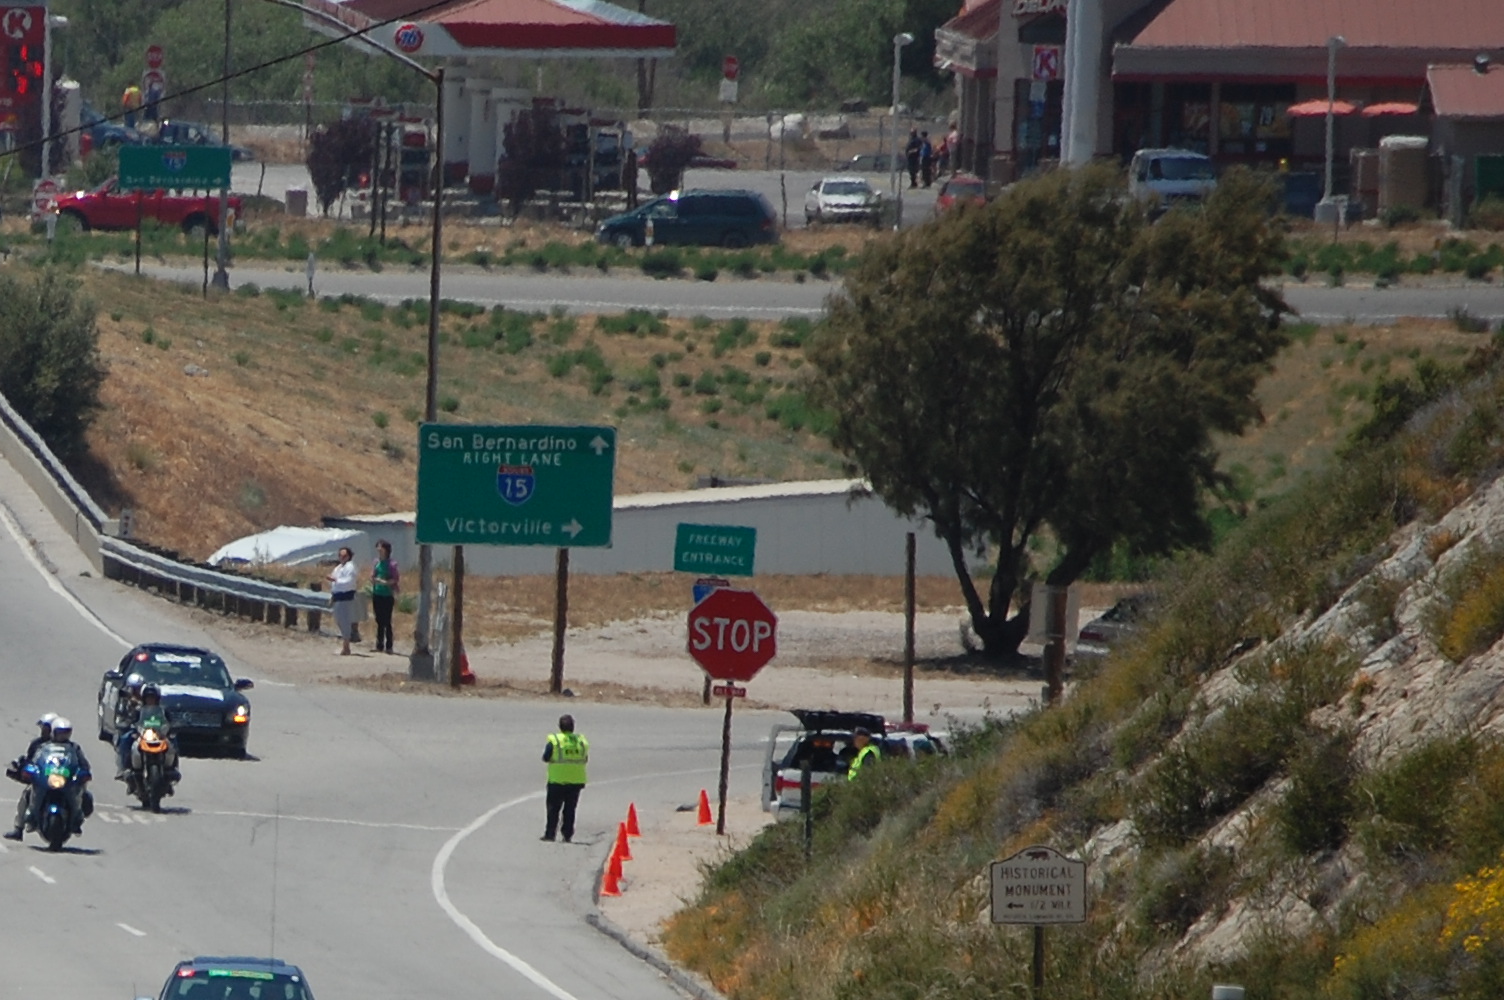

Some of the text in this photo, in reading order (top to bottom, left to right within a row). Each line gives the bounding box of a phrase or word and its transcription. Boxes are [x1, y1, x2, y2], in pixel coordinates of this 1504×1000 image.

[428, 432, 577, 450] San Bernardino
[463, 452, 562, 466] RIGHT LANE
[505, 477, 528, 498] 15
[445, 517, 553, 535] Victorville
[688, 533, 743, 547] FREEWAY
[682, 551, 745, 567] ENTRANCE
[692, 616, 772, 653] STOP
[1000, 867, 1075, 879] HISTORICAL
[1005, 884, 1072, 897] MONUMENT
